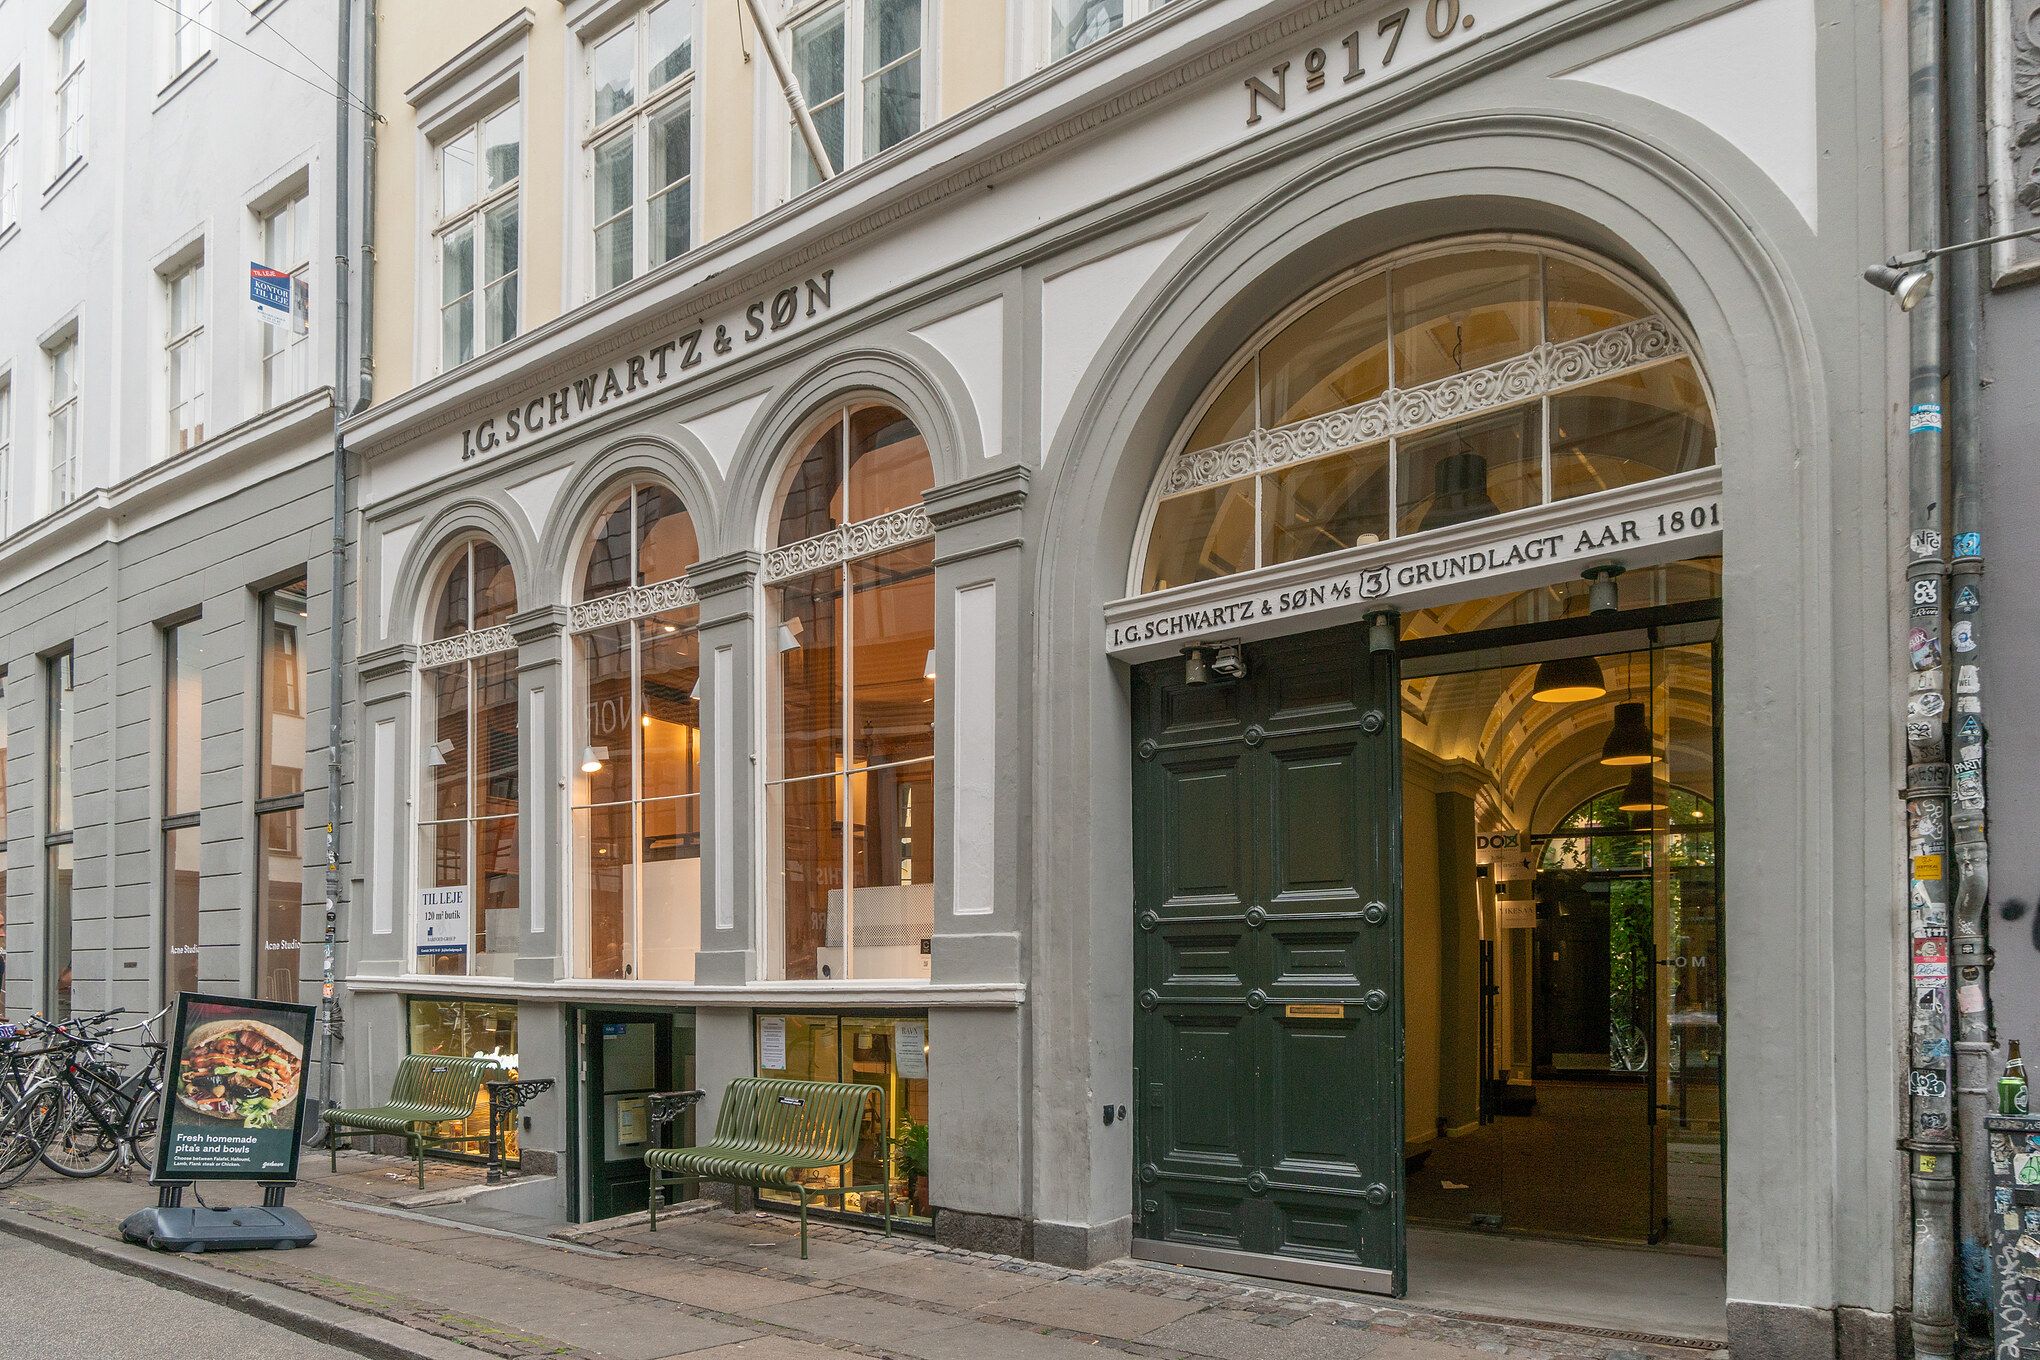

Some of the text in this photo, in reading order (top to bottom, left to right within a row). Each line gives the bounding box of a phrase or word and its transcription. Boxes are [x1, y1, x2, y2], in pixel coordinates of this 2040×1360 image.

[254, 287, 289, 305] TIL LEJE
[255, 280, 289, 298] KONTOR
[712, 324, 732, 355] &
[744, 269, 834, 342] SØN
[1260, 599, 1272, 616] &
[1279, 585, 1325, 612] SØN
[1396, 534, 1564, 587] GRUNDLAGT
[1573, 520, 1640, 553] AAR
[1657, 502, 1720, 536] 1801
[1953, 758, 1982, 774] PARTY
[422, 891, 463, 905] TIL LEJE
[444, 910, 461, 920] butik
[171, 946, 183, 954] Acne
[265, 940, 280, 950] Acne
[176, 1133, 258, 1144] Fresh homemade
[202, 1144, 221, 1153] and
[223, 1144, 250, 1154] bowls
